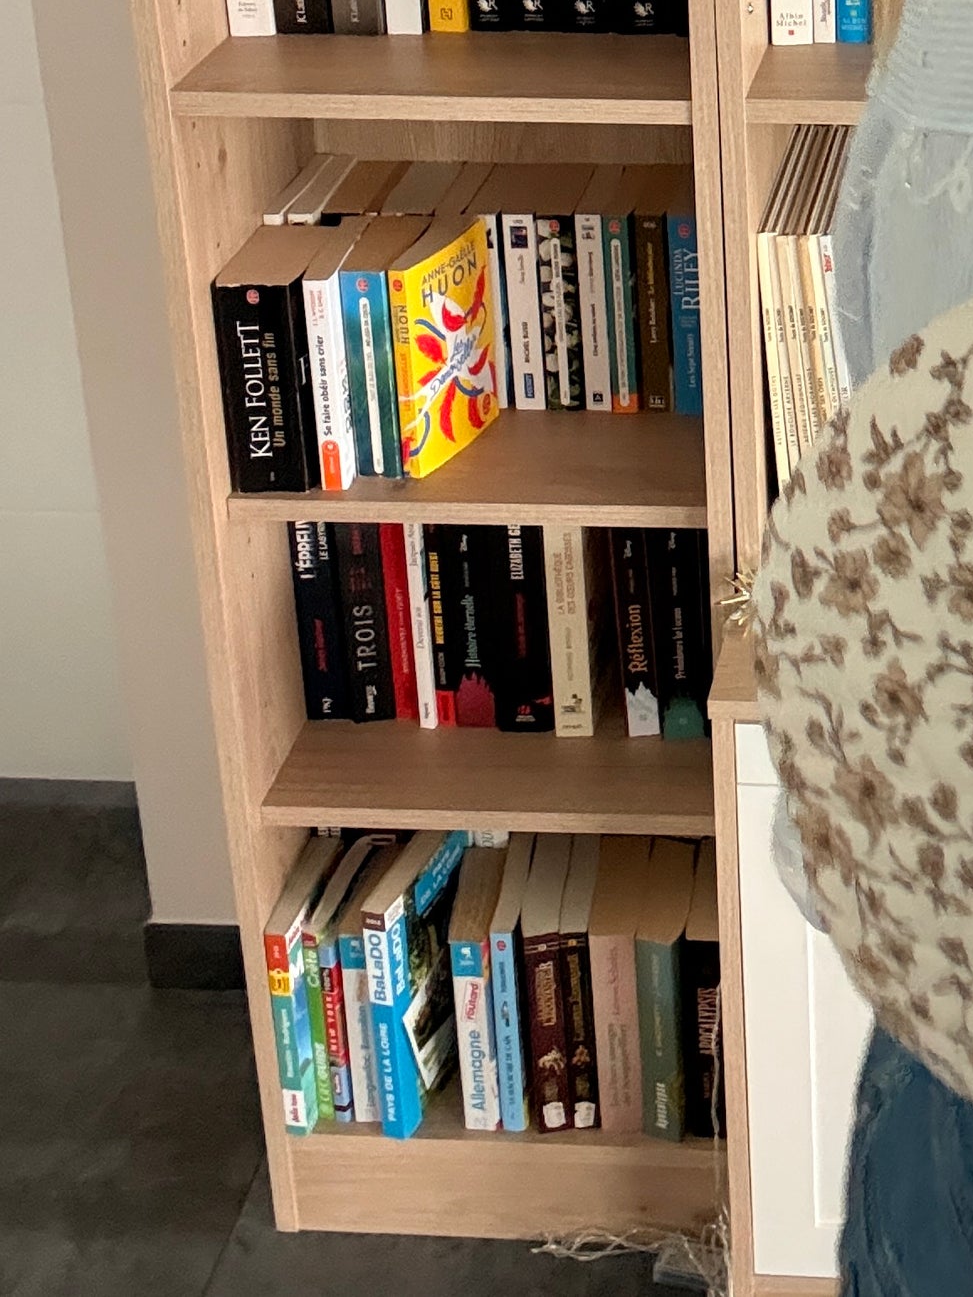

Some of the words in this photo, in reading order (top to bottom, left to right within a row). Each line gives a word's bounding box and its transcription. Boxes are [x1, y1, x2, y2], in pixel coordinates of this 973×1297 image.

[421, 241, 476, 285] ANNE-GAËLLE
[673, 248, 684, 295] LUCINDA
[422, 256, 477, 308] HUON
[262, 332, 275, 348] fin
[399, 305, 410, 344] HUON
[316, 335, 325, 355] crier
[237, 320, 267, 407] FOLLETT
[267, 352, 278, 381] sans
[317, 357, 327, 376] sans
[267, 386, 283, 426] monde
[318, 379, 330, 402] obéir
[321, 404, 331, 424] faire
[323, 426, 332, 436] Se
[247, 416, 273, 458] KEN
[273, 430, 286, 447] Un
[320, 550, 329, 560] LE
[508, 538, 525, 580] ELIZABETH
[460, 594, 478, 631] éternelle
[353, 605, 377, 671] TROIS
[415, 619, 425, 649] Devenir
[465, 632, 482, 667] Histoire
[626, 604, 648, 673] Réflexion
[304, 950, 321, 987] Crête
[367, 933, 387, 1001] BaLaDO
[388, 922, 407, 995] BaLaDO
[326, 995, 336, 1023] YORK
[465, 982, 479, 1022] routard
[379, 1023, 391, 1056] LOIRE
[697, 988, 718, 1055] APOCALYPSIS
[329, 1028, 338, 1052] NEW
[382, 1058, 393, 1073] LA
[382, 1075, 395, 1091] DE
[466, 1030, 486, 1112] Allemagne
[383, 1093, 396, 1122] PAYS
